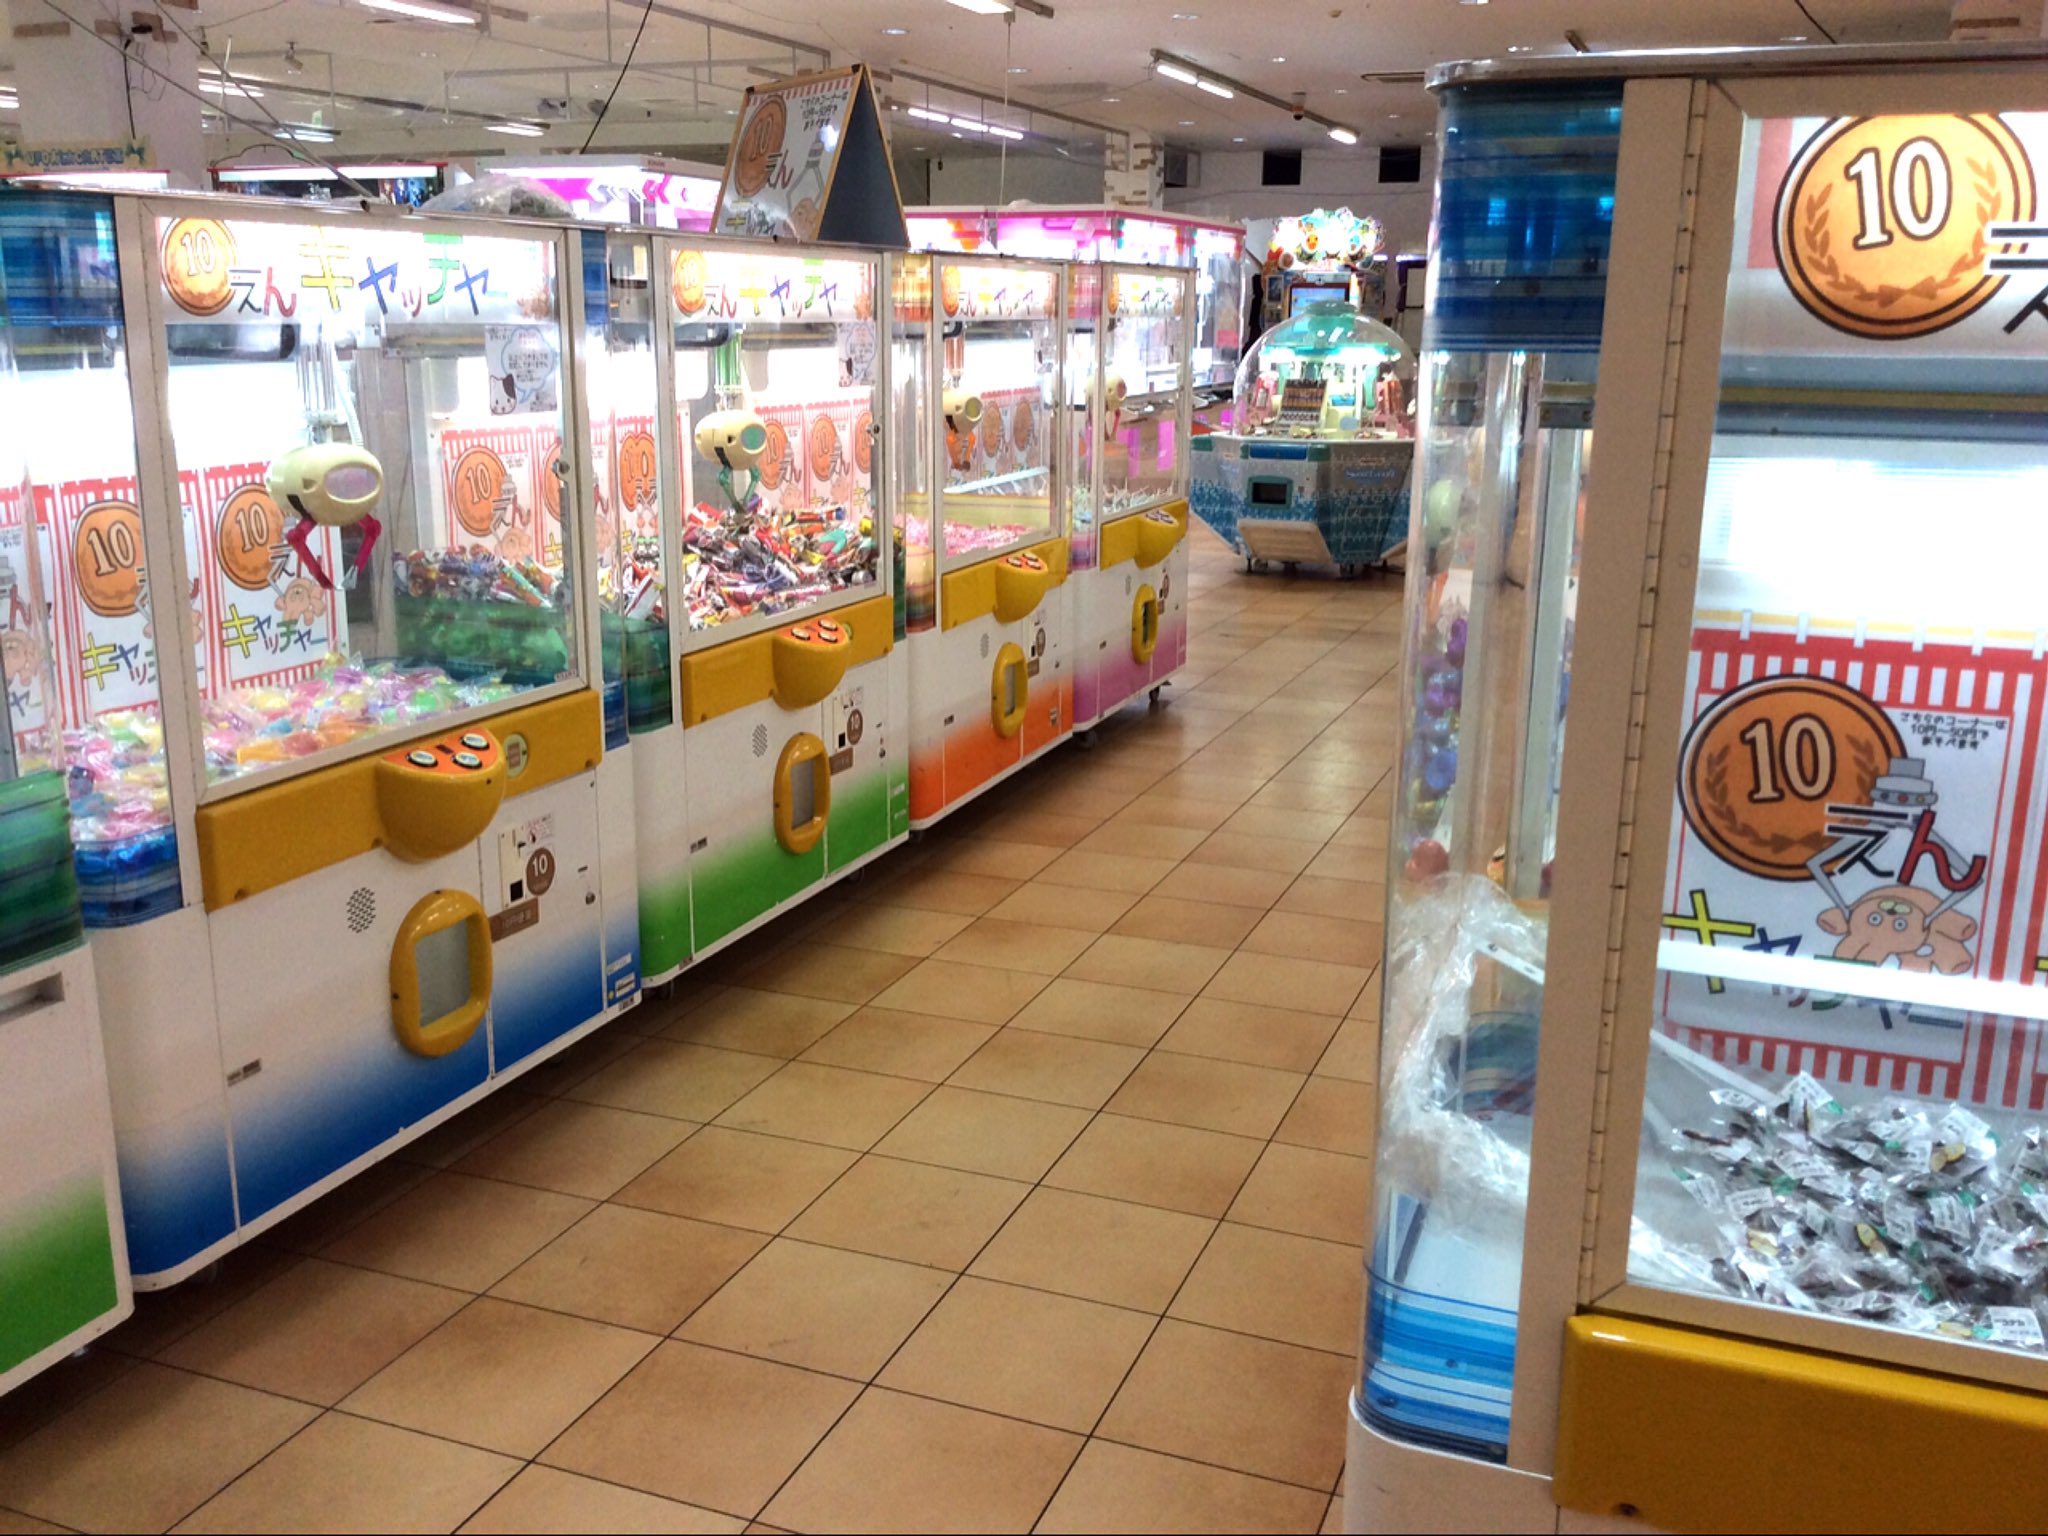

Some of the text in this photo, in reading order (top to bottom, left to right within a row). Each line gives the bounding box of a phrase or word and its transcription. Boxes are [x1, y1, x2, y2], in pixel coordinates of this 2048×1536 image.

[750, 115, 774, 163] 10
[1843, 135, 1953, 251] 10
[180, 229, 216, 277] 10
[228, 266, 297, 318] えん
[704, 283, 737, 319] えん
[466, 463, 492, 505] 10
[87, 520, 136, 576] 10
[235, 501, 270, 554] 10
[222, 603, 329, 659] キャッチャー
[1900, 711, 2008, 731] こちらのコーナーは
[1739, 712, 1988, 893] 10 えん
[532, 853, 549, 878] 10
